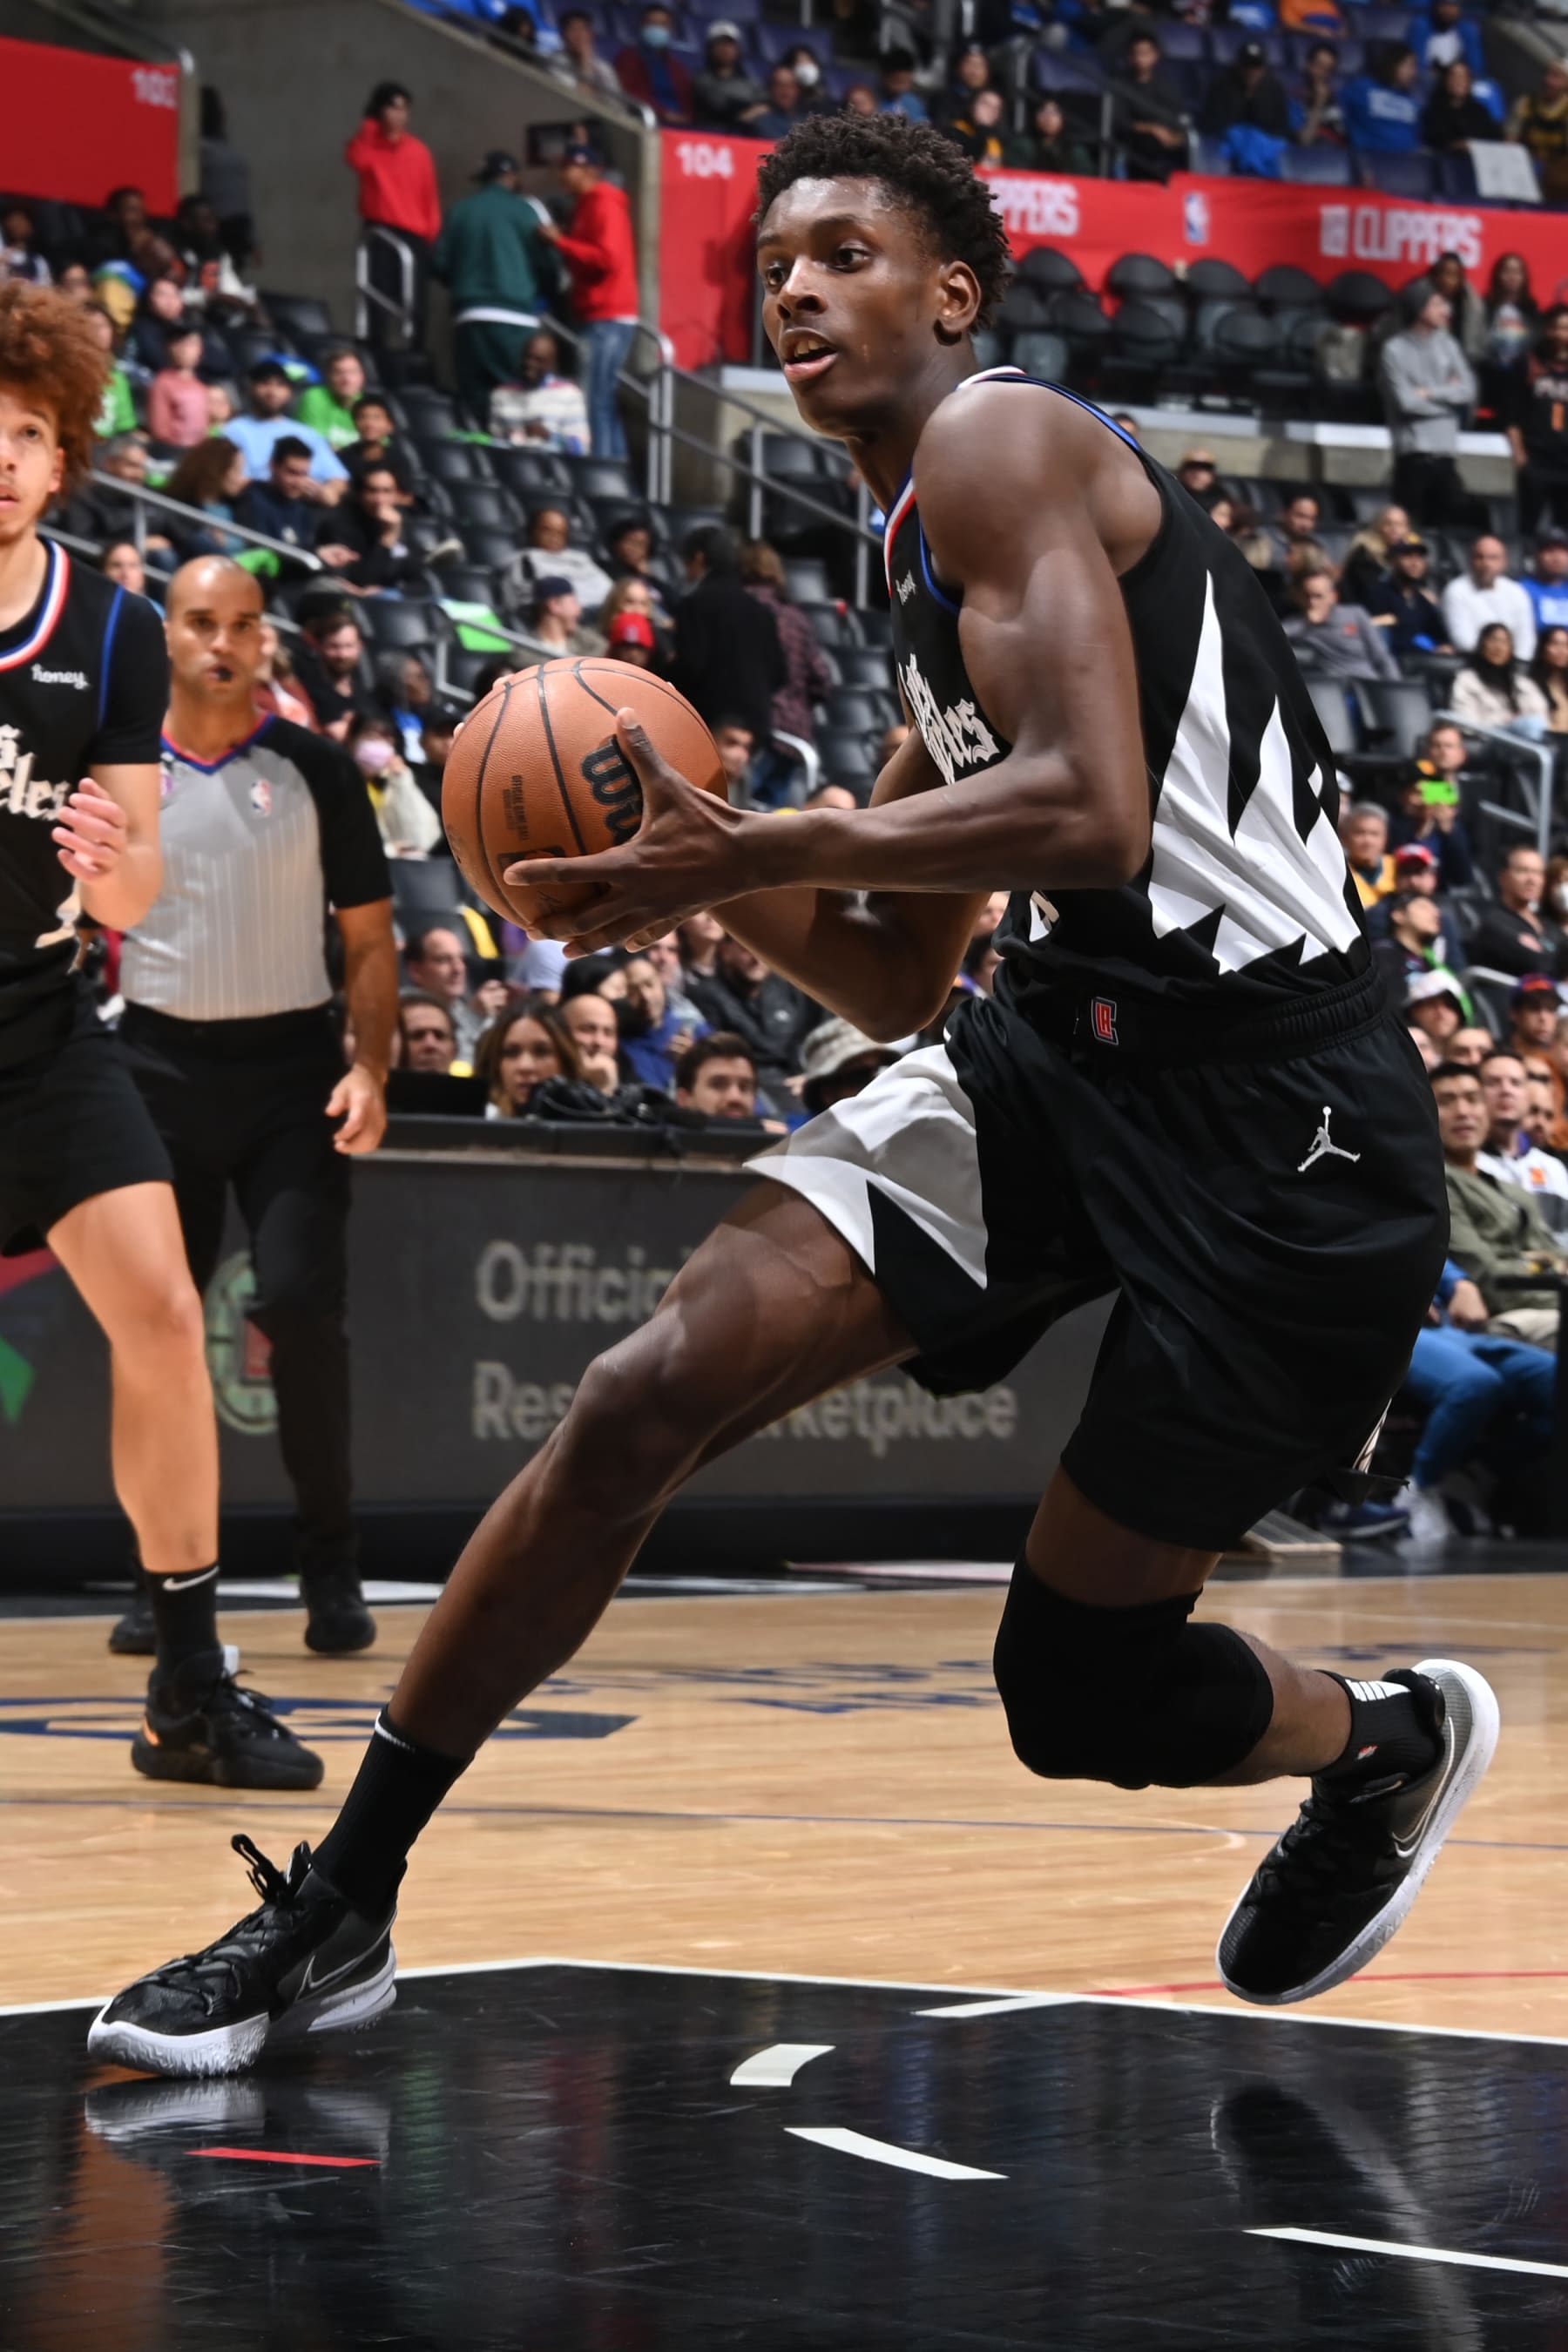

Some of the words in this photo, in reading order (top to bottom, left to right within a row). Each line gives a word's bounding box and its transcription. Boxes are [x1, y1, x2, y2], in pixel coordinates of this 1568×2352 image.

[676, 142, 735, 179] 104
[989, 177, 1080, 236] PPERS
[1354, 205, 1483, 269] CLIPPERS
[31, 664, 90, 690] honey
[476, 1239, 696, 1324] Officia
[472, 1360, 576, 1442] Res
